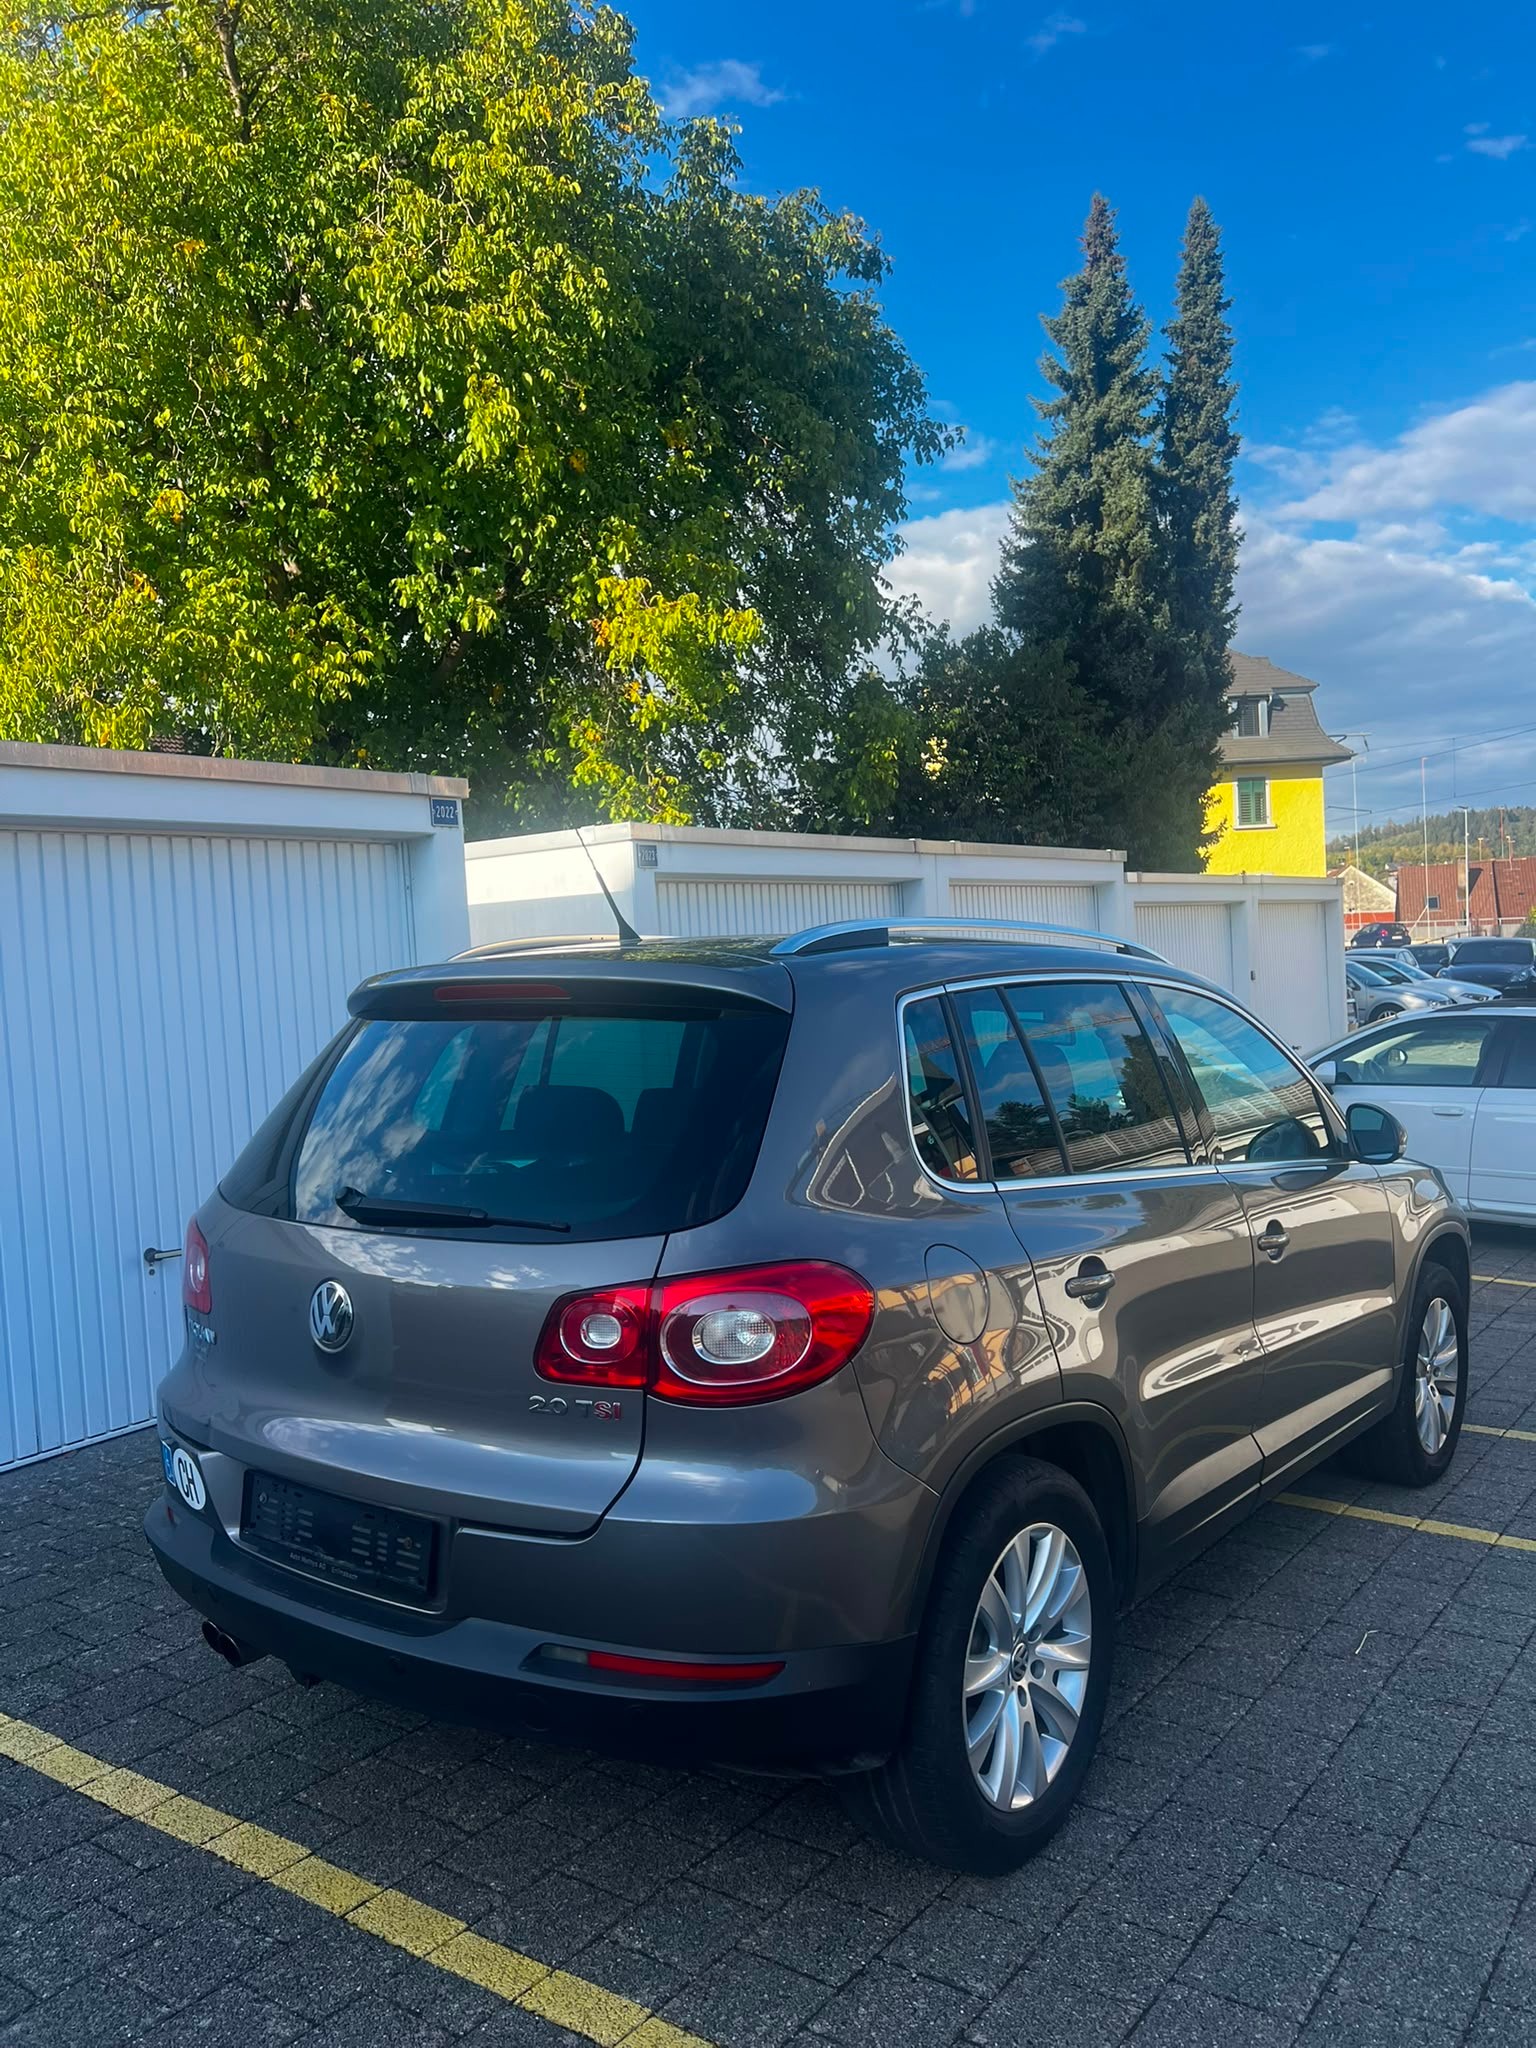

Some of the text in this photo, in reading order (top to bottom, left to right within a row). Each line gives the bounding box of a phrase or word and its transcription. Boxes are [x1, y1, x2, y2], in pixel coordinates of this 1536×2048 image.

[435, 805, 455, 819] 2022
[311, 1282, 352, 1348] VW
[575, 1399, 622, 1421] TSI
[178, 1457, 200, 1504] CH
